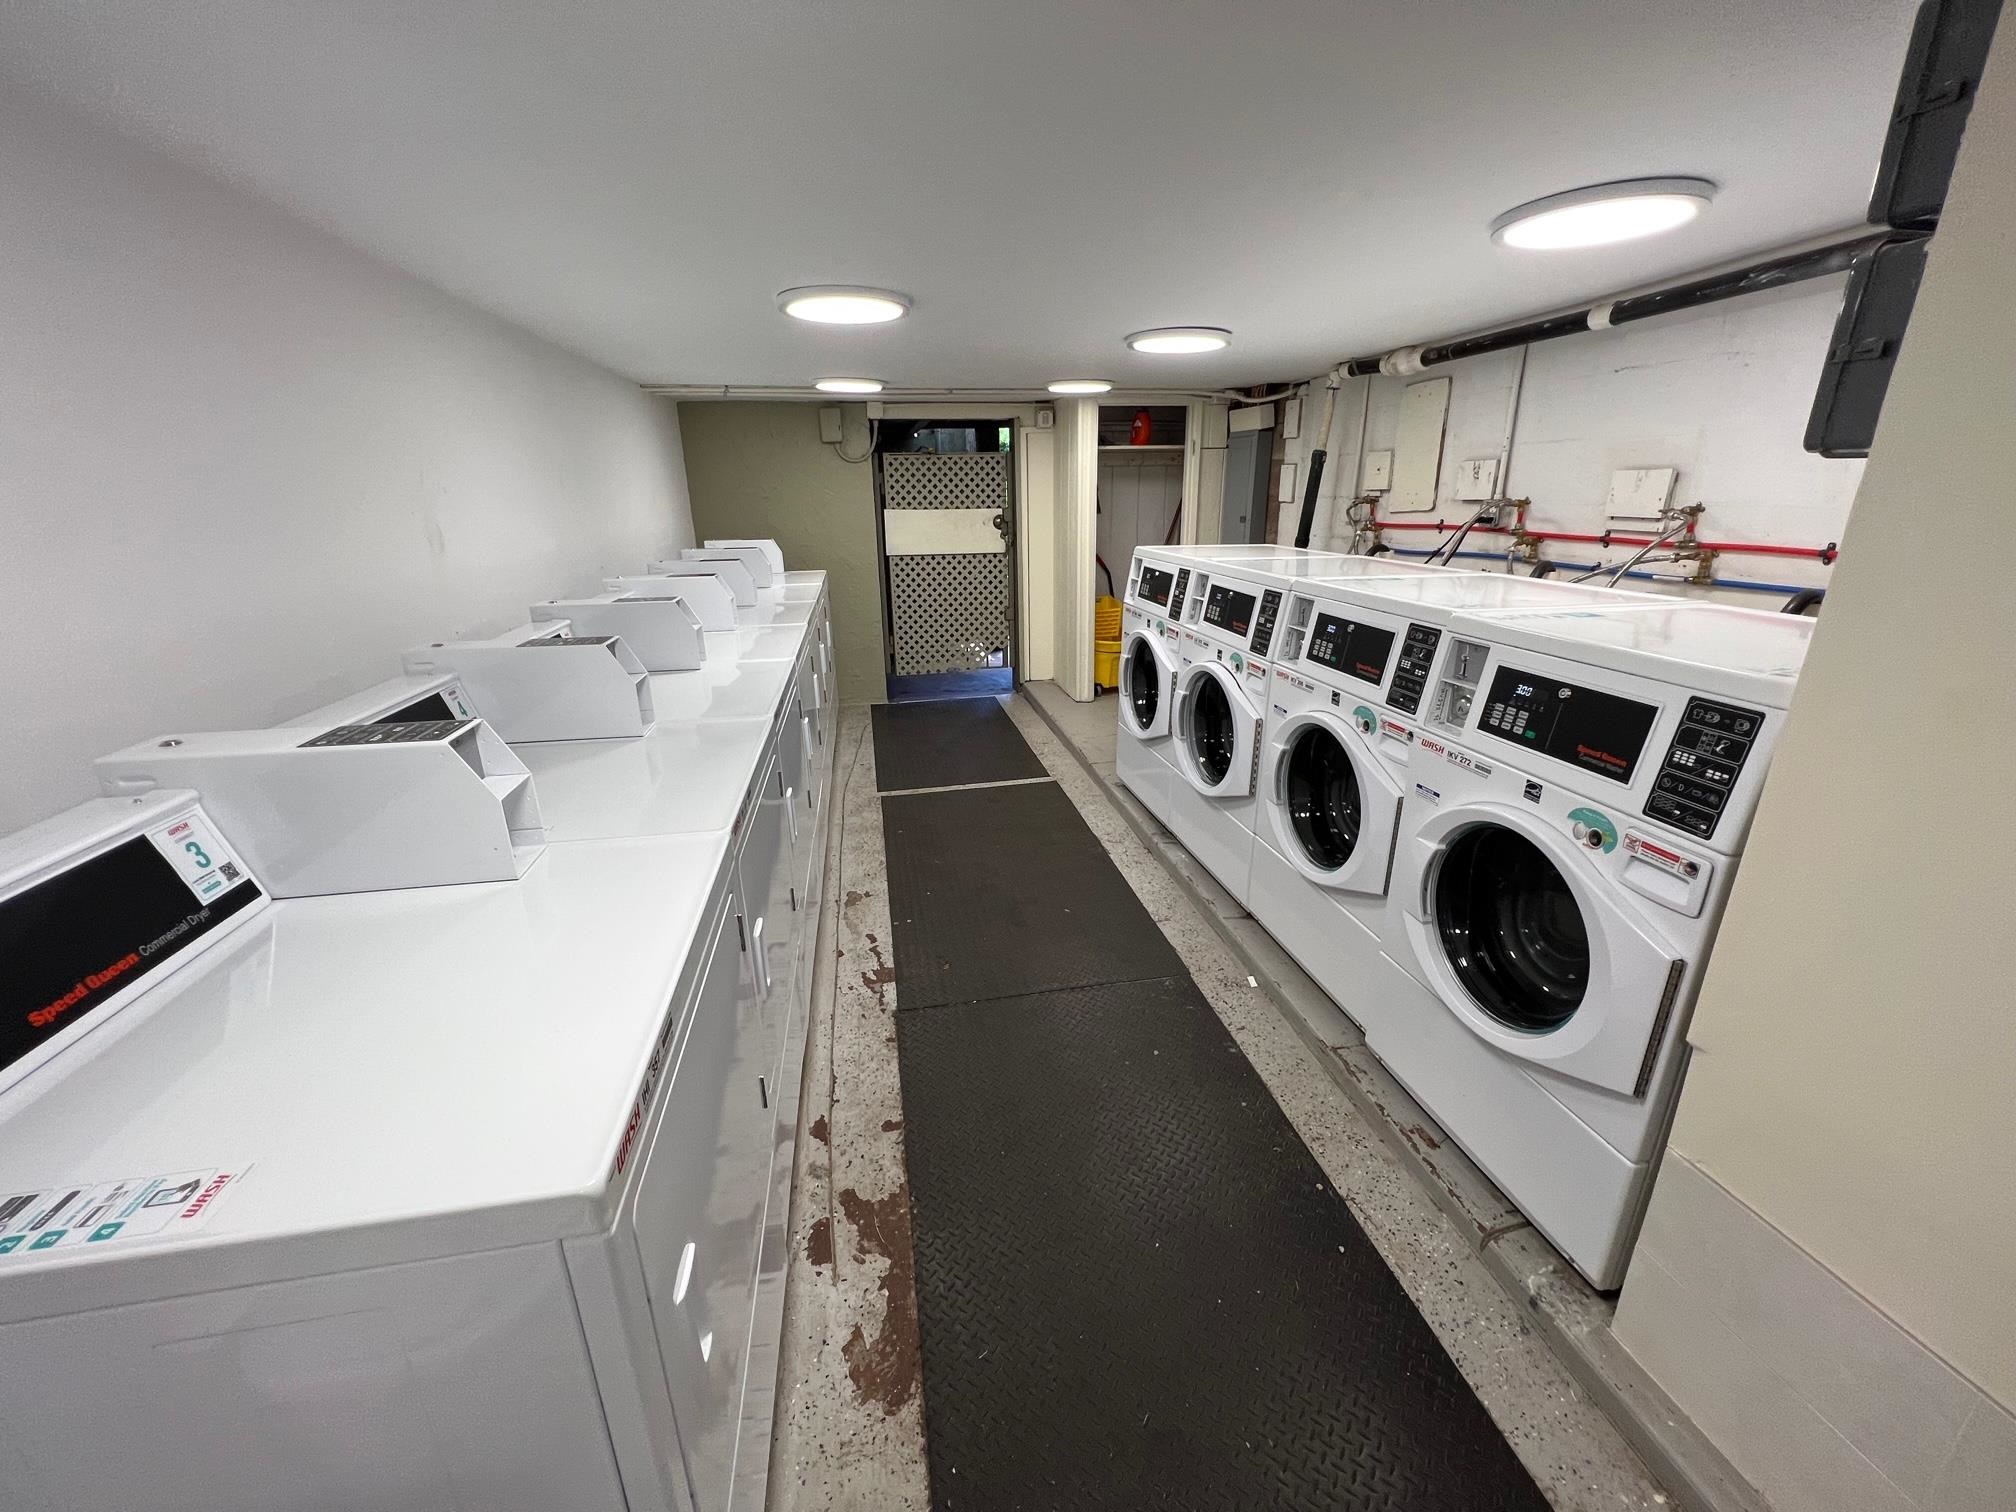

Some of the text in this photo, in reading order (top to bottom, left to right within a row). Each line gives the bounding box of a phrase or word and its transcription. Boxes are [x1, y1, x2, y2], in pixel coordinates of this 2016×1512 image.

[1421, 738, 1445, 754] WASH
[167, 821, 190, 836] WASH
[185, 841, 211, 868] 3
[27, 907, 212, 1027] Speed Queen Commercial Dryer
[616, 1103, 641, 1175] WASH
[180, 1174, 231, 1218] WASH
